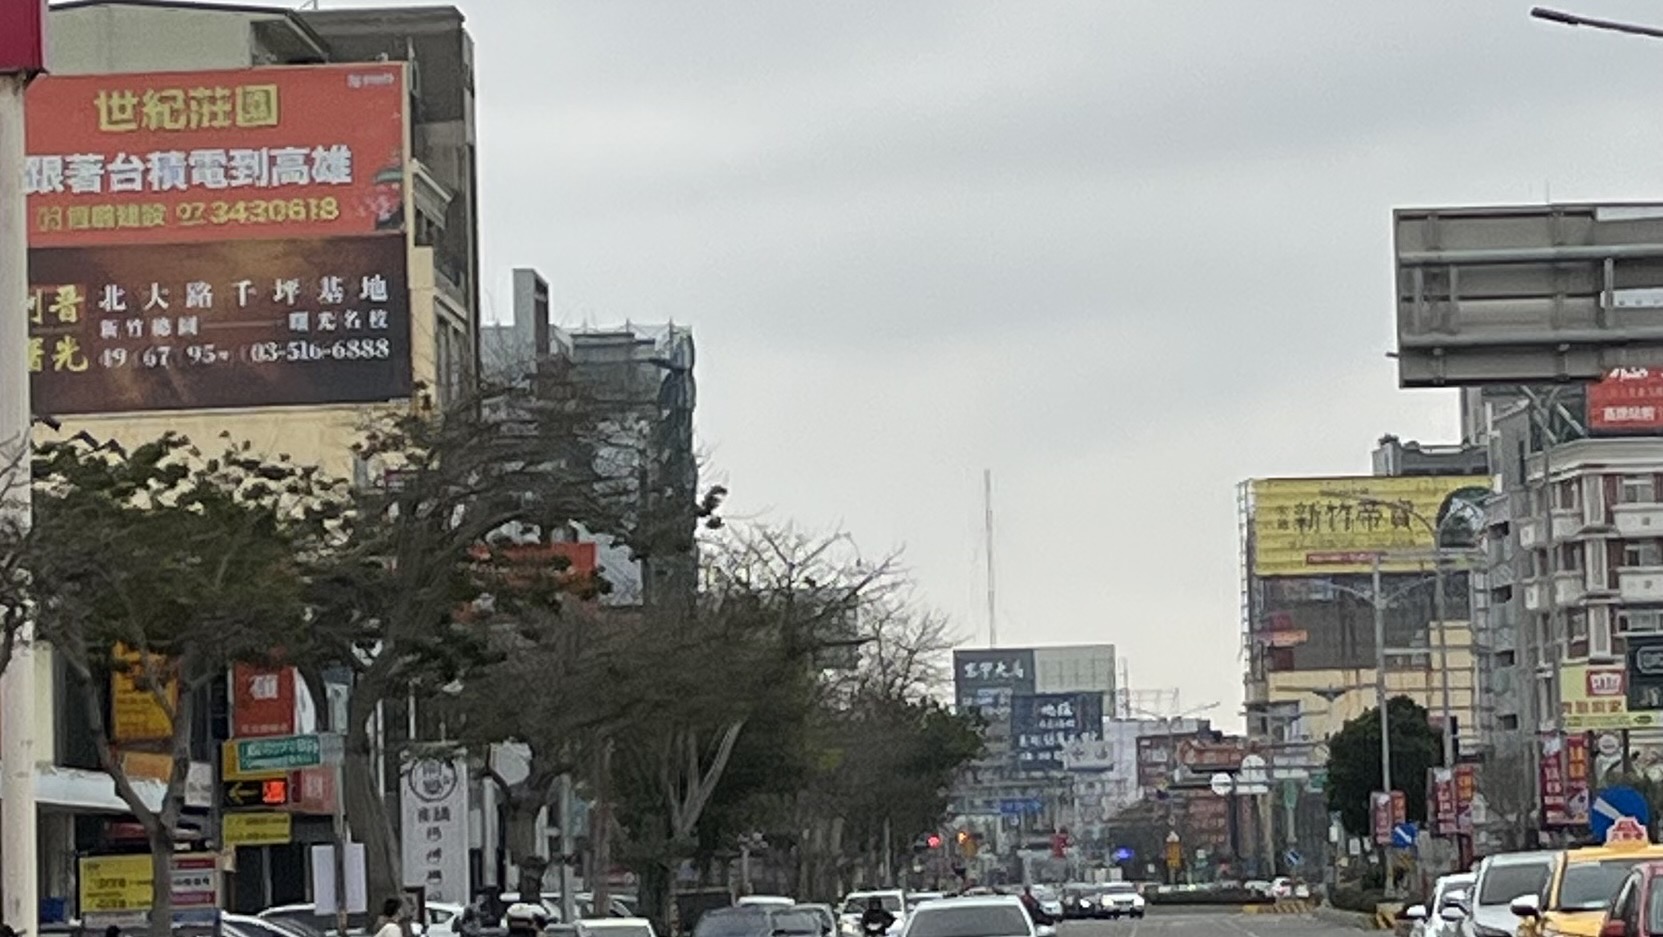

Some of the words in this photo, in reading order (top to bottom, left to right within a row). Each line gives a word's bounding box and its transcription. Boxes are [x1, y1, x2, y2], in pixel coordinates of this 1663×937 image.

[24, 143, 353, 195] 跟著台積電到高雄
[210, 197, 339, 224] 3430618
[99, 274, 388, 312] 北大路千坪基地
